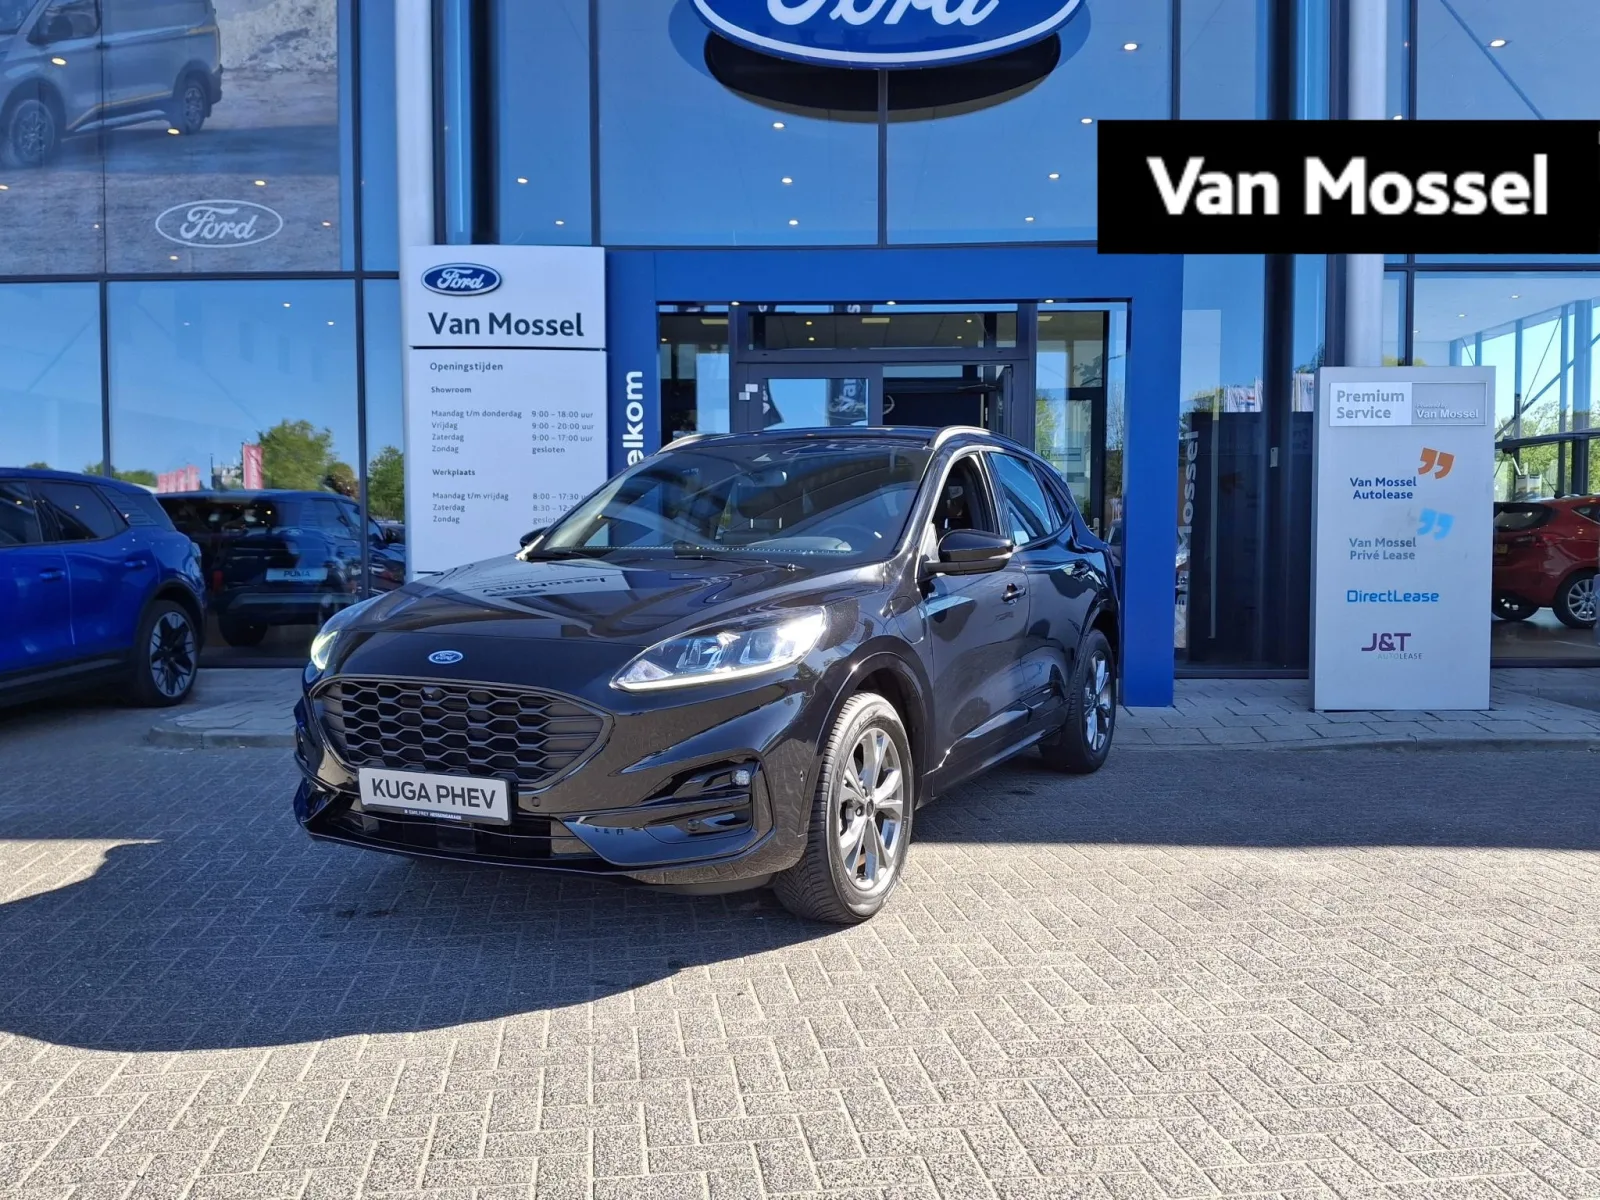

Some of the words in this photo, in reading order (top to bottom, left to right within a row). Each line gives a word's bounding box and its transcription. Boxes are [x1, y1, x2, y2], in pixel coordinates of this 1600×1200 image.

[766, 0, 1001, 26] or
[180, 206, 259, 239] Ford
[436, 268, 485, 290] Ford
[427, 312, 480, 335] Van
[489, 312, 584, 337] Mossel
[430, 362, 503, 372] Openingstijden
[1336, 389, 1405, 402] Premium
[432, 410, 464, 418] Maandag
[482, 410, 522, 419] donderdag
[1336, 407, 1391, 419] Service
[1417, 409, 1437, 418] Van
[1440, 408, 1479, 418] Mossel
[622, 371, 644, 467] elkom
[432, 422, 458, 430] Vrijdag
[432, 433, 465, 442] Zaterdag
[432, 445, 459, 454] Zondag
[532, 446, 565, 455] gesloten
[432, 469, 476, 477] Werkplaats
[1349, 478, 1372, 487] Van
[1375, 477, 1417, 487] Mossel
[432, 492, 465, 501] Maandag
[467, 492, 481, 500] t/m
[483, 492, 509, 501] vrijdag
[1353, 490, 1413, 499] Autolease
[432, 504, 465, 513] Zaterdag
[433, 516, 460, 525] Zondag
[533, 516, 558, 525] geslot
[1349, 538, 1371, 548] Van
[1375, 537, 1417, 548] Mossel
[1350, 550, 1379, 560] Privé
[1383, 551, 1415, 560] Lease
[284, 570, 311, 578] PUMA
[1346, 590, 1439, 603] DirectLease
[1361, 633, 1411, 651] J&T
[371, 778, 432, 803] KUGA
[436, 784, 496, 809] PHEV
